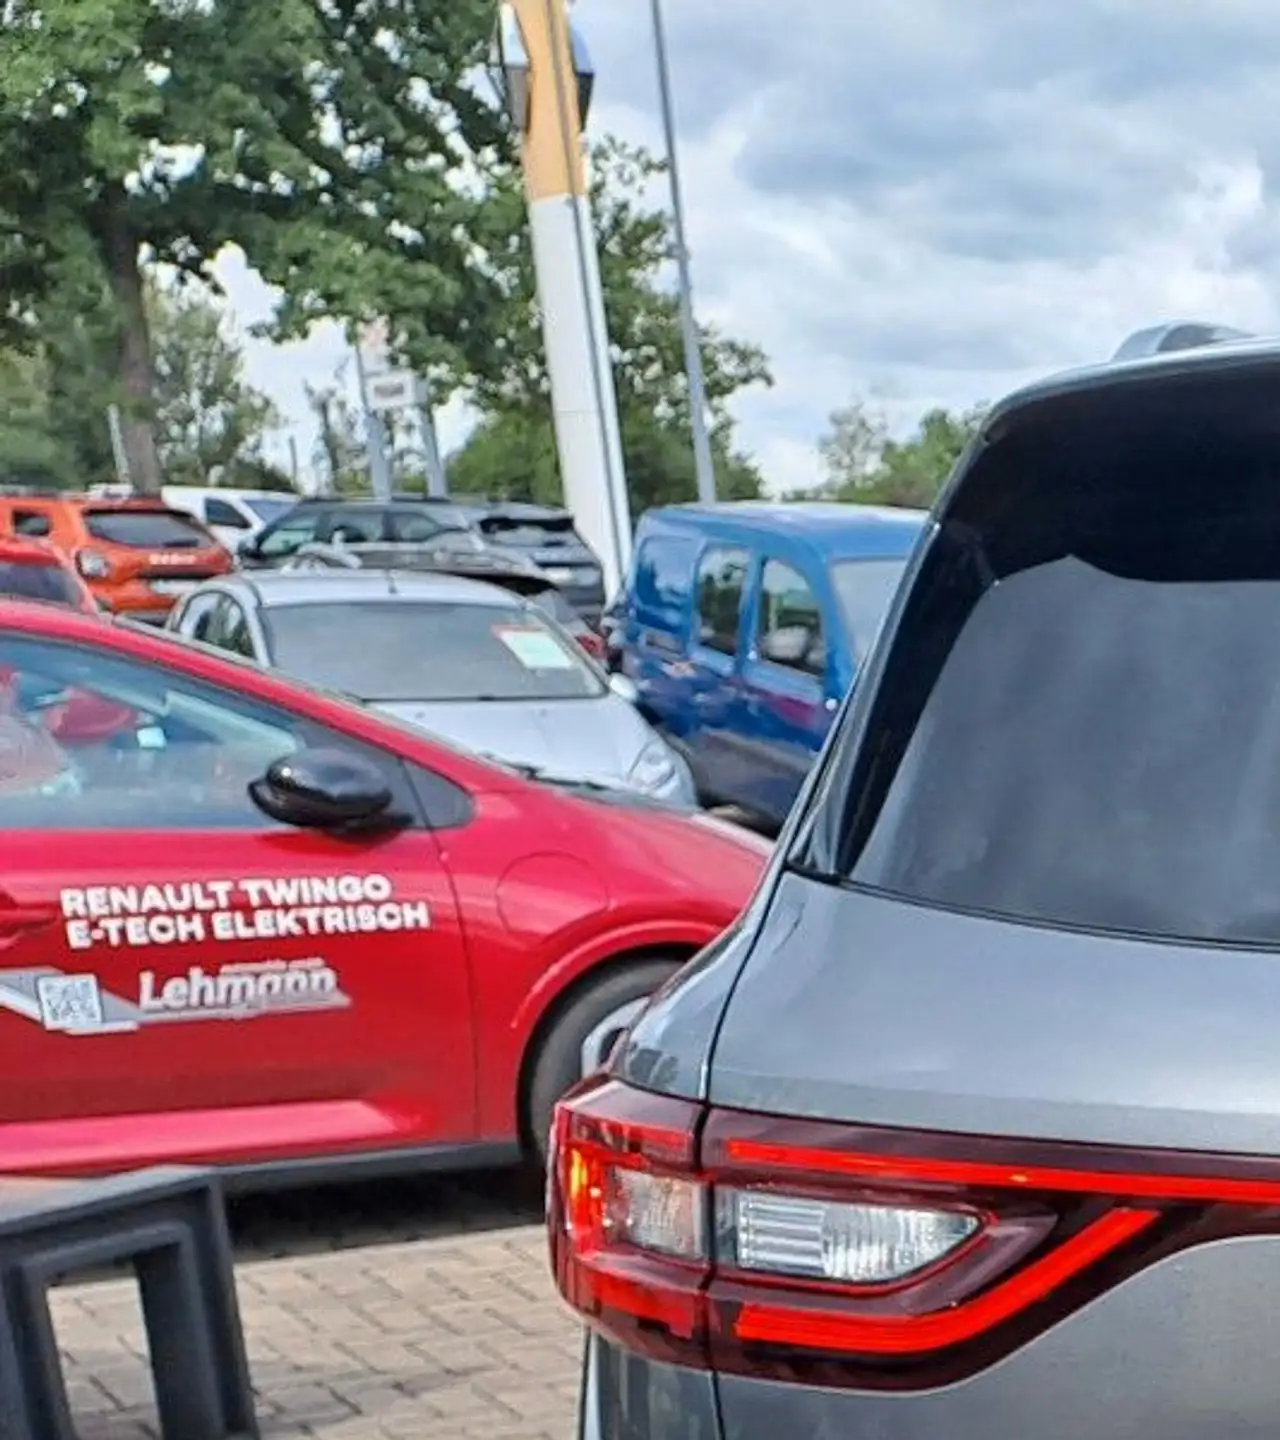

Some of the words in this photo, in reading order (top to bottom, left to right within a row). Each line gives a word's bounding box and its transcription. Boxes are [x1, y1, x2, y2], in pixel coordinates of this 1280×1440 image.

[60, 880, 235, 918] RENAULT
[238, 873, 393, 907] TWINGO
[66, 913, 206, 949] E-TECH
[211, 901, 431, 941] ELEKTRISCH
[139, 966, 338, 1010] Lehmann
